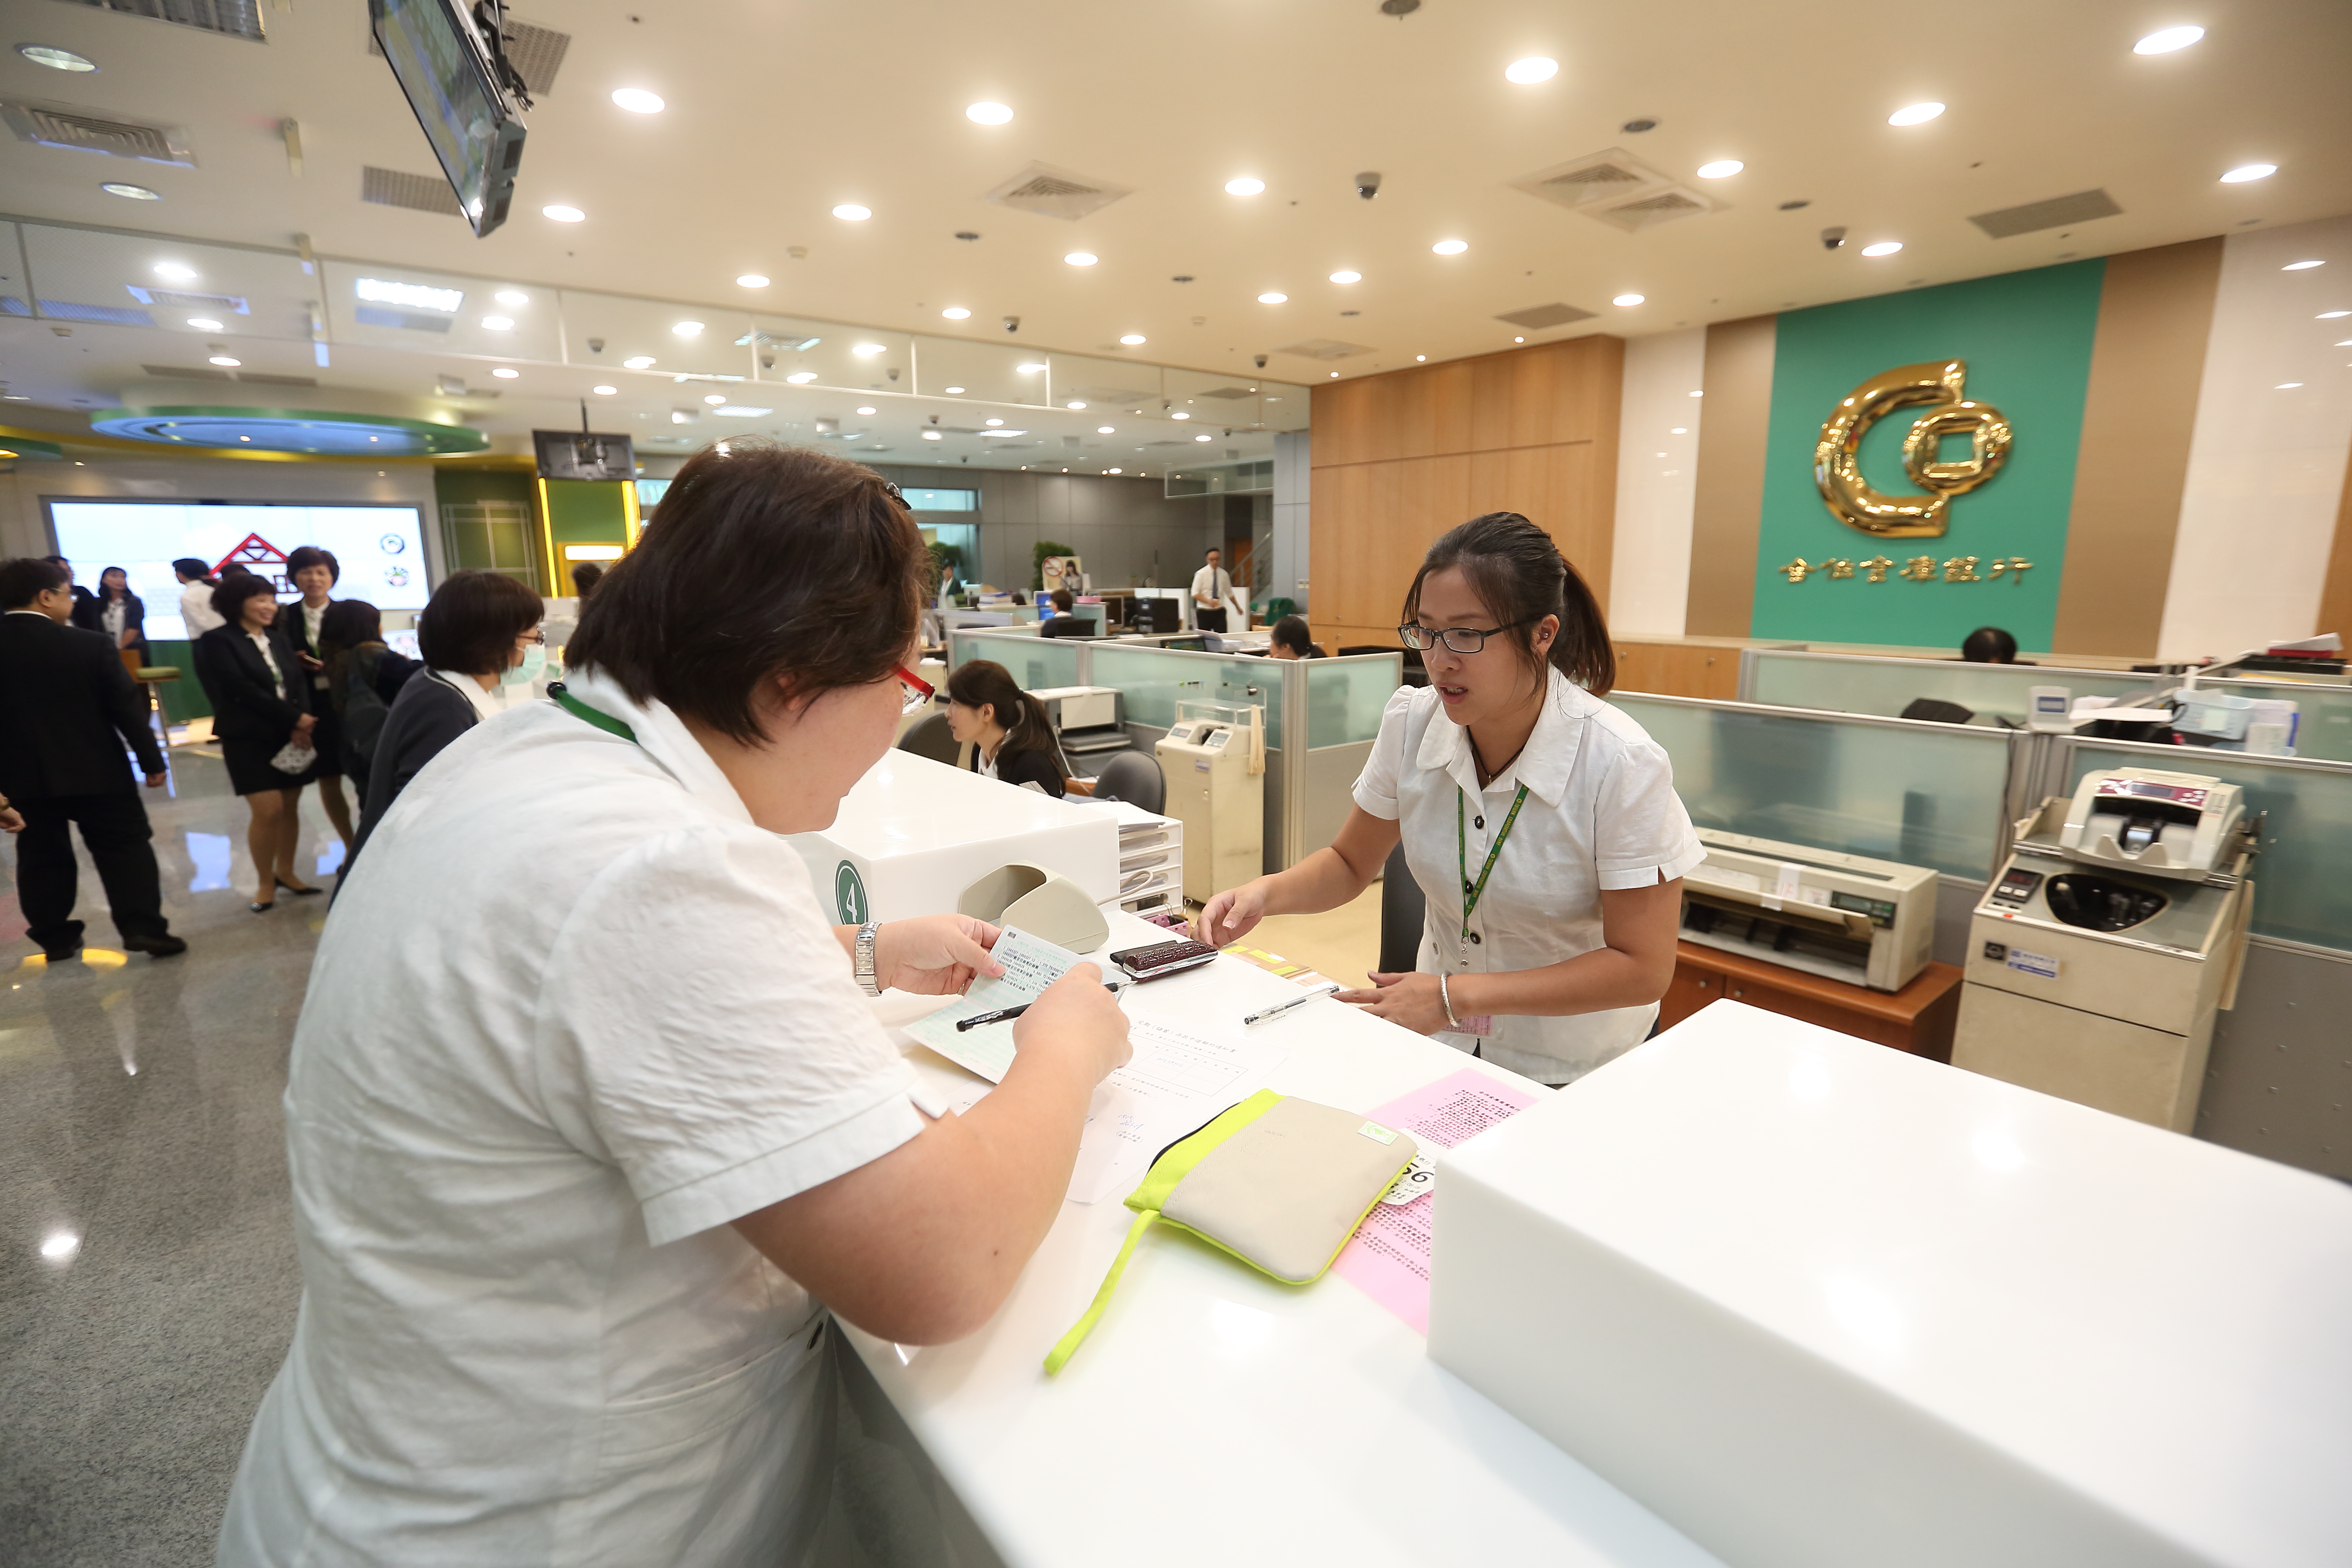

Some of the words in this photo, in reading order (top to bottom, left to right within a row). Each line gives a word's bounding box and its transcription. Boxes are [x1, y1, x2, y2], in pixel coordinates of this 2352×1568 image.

[1511, 803, 1520, 815] TAIWAN
[1501, 817, 1513, 836] COOPERATIVE
[1485, 859, 1493, 869] TAIWAN
[1476, 871, 1488, 889] COOPERATIVE
[846, 883, 858, 924] 4
